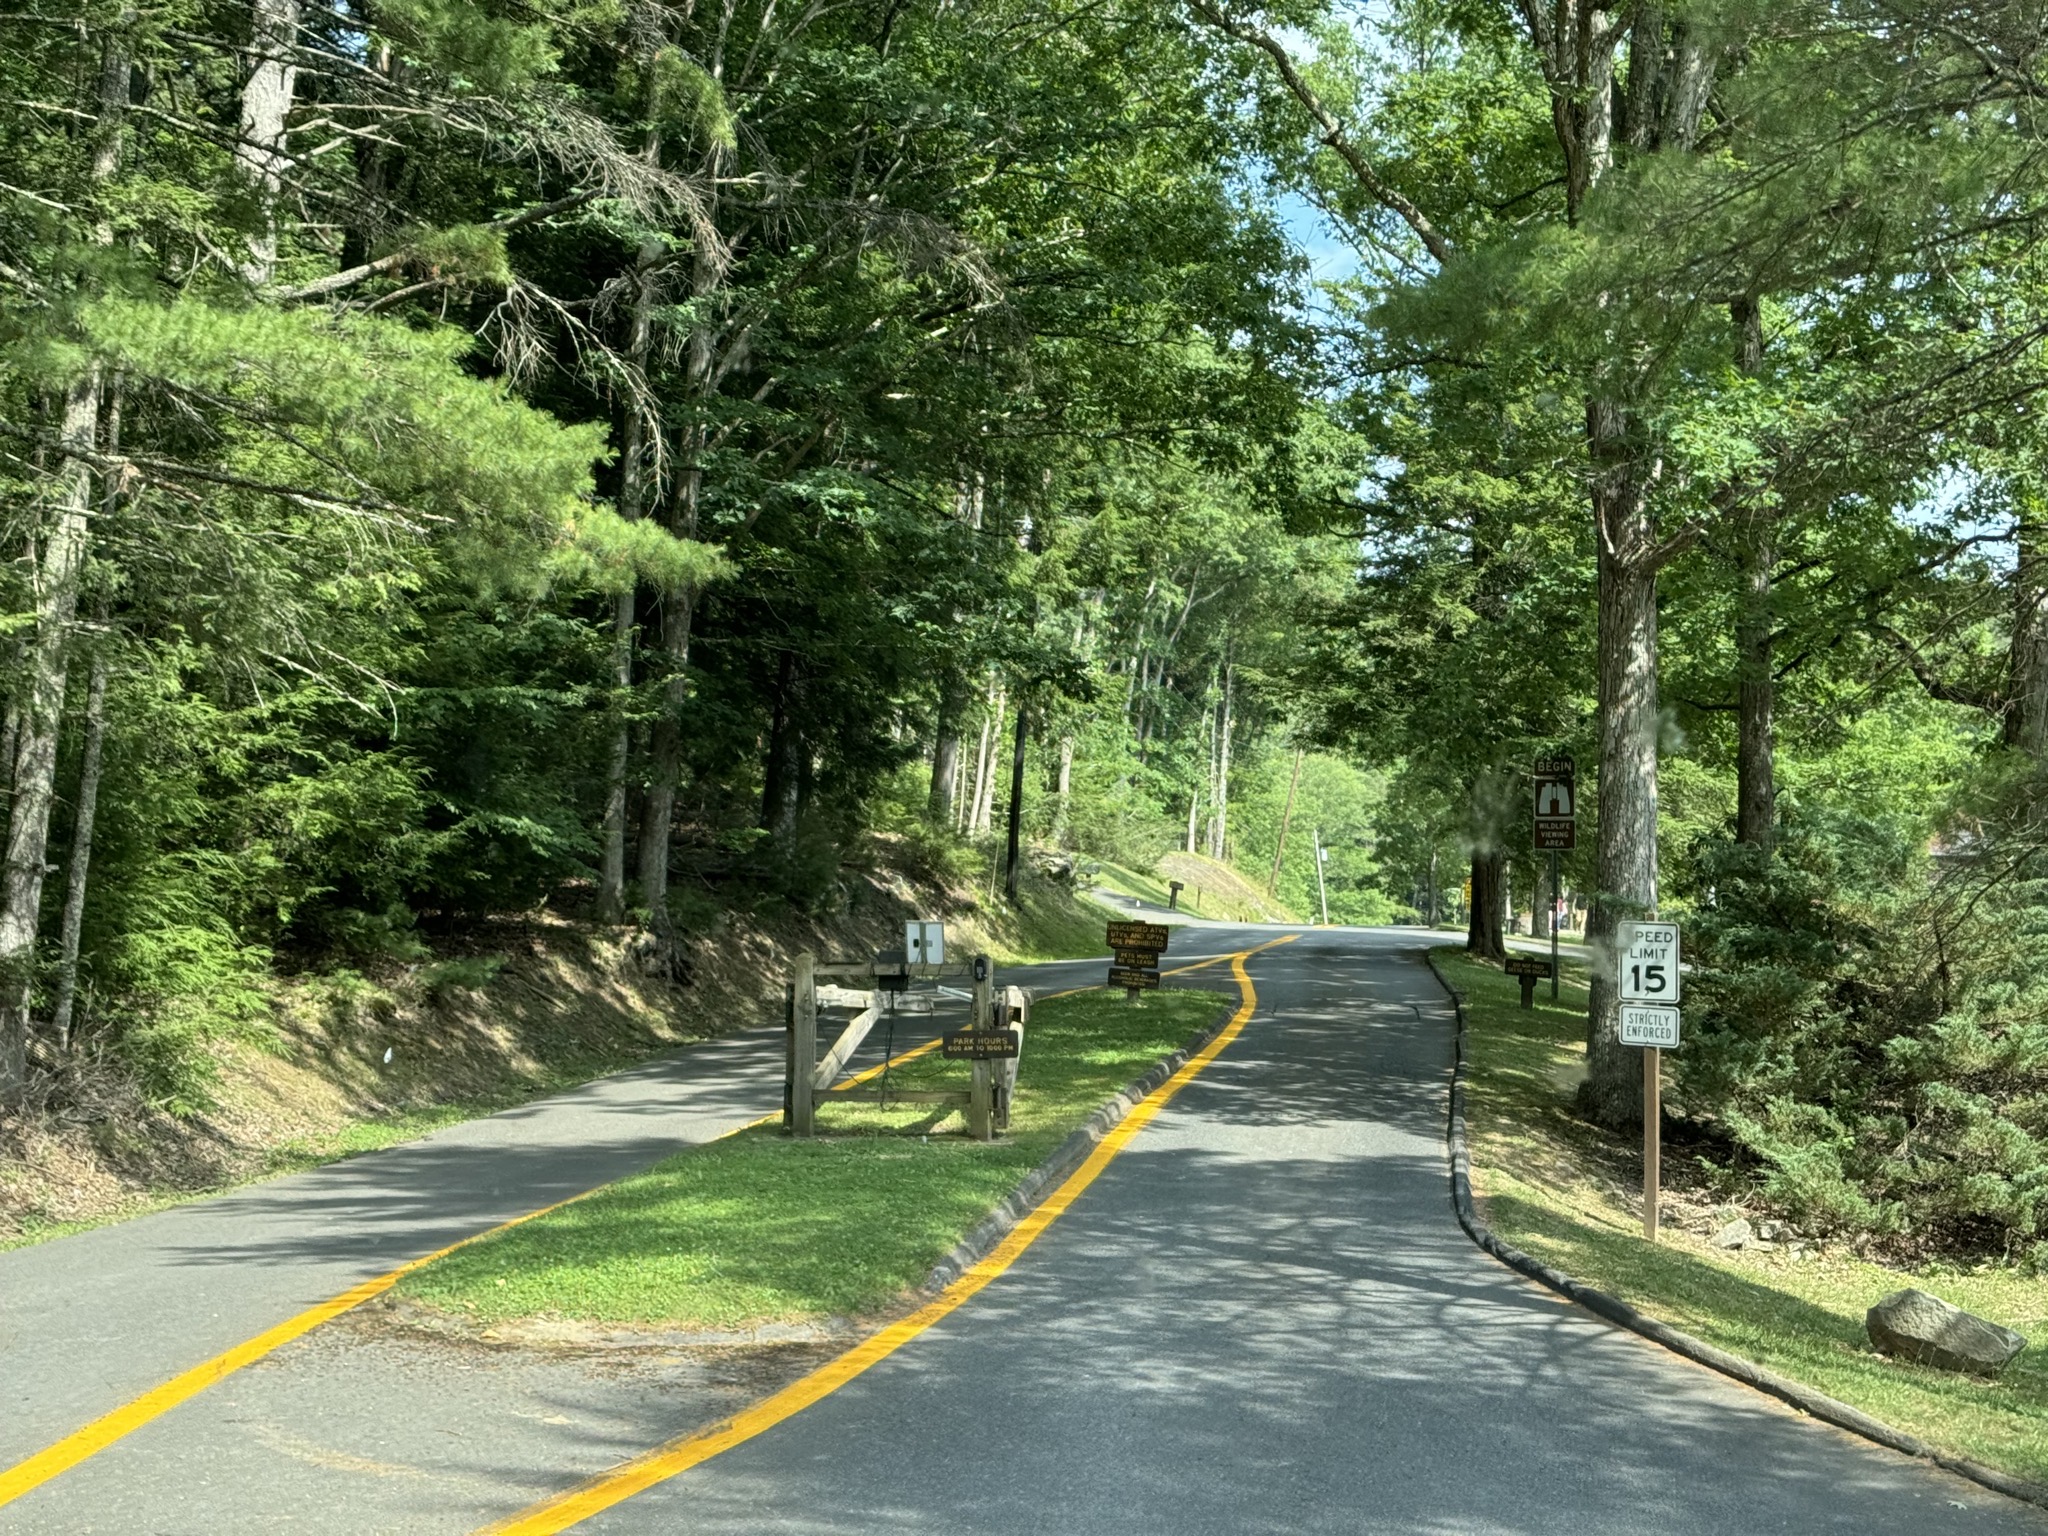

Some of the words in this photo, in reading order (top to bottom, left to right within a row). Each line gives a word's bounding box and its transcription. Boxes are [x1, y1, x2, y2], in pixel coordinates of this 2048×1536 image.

[1538, 761, 1572, 772] BEGIN
[1538, 822, 1571, 830] WILDLIFE
[1544, 839, 1565, 847] AREA
[1624, 930, 1673, 943] PEED
[1125, 939, 1164, 948] PROHIBITED
[1630, 947, 1668, 960] LIMIT
[1631, 964, 1666, 993] 15
[1628, 1012, 1670, 1027] STRICTLY
[1626, 1025, 1672, 1039] ENFORCED
[953, 1037, 974, 1045] PARK
[978, 1037, 1008, 1045] HOURS
